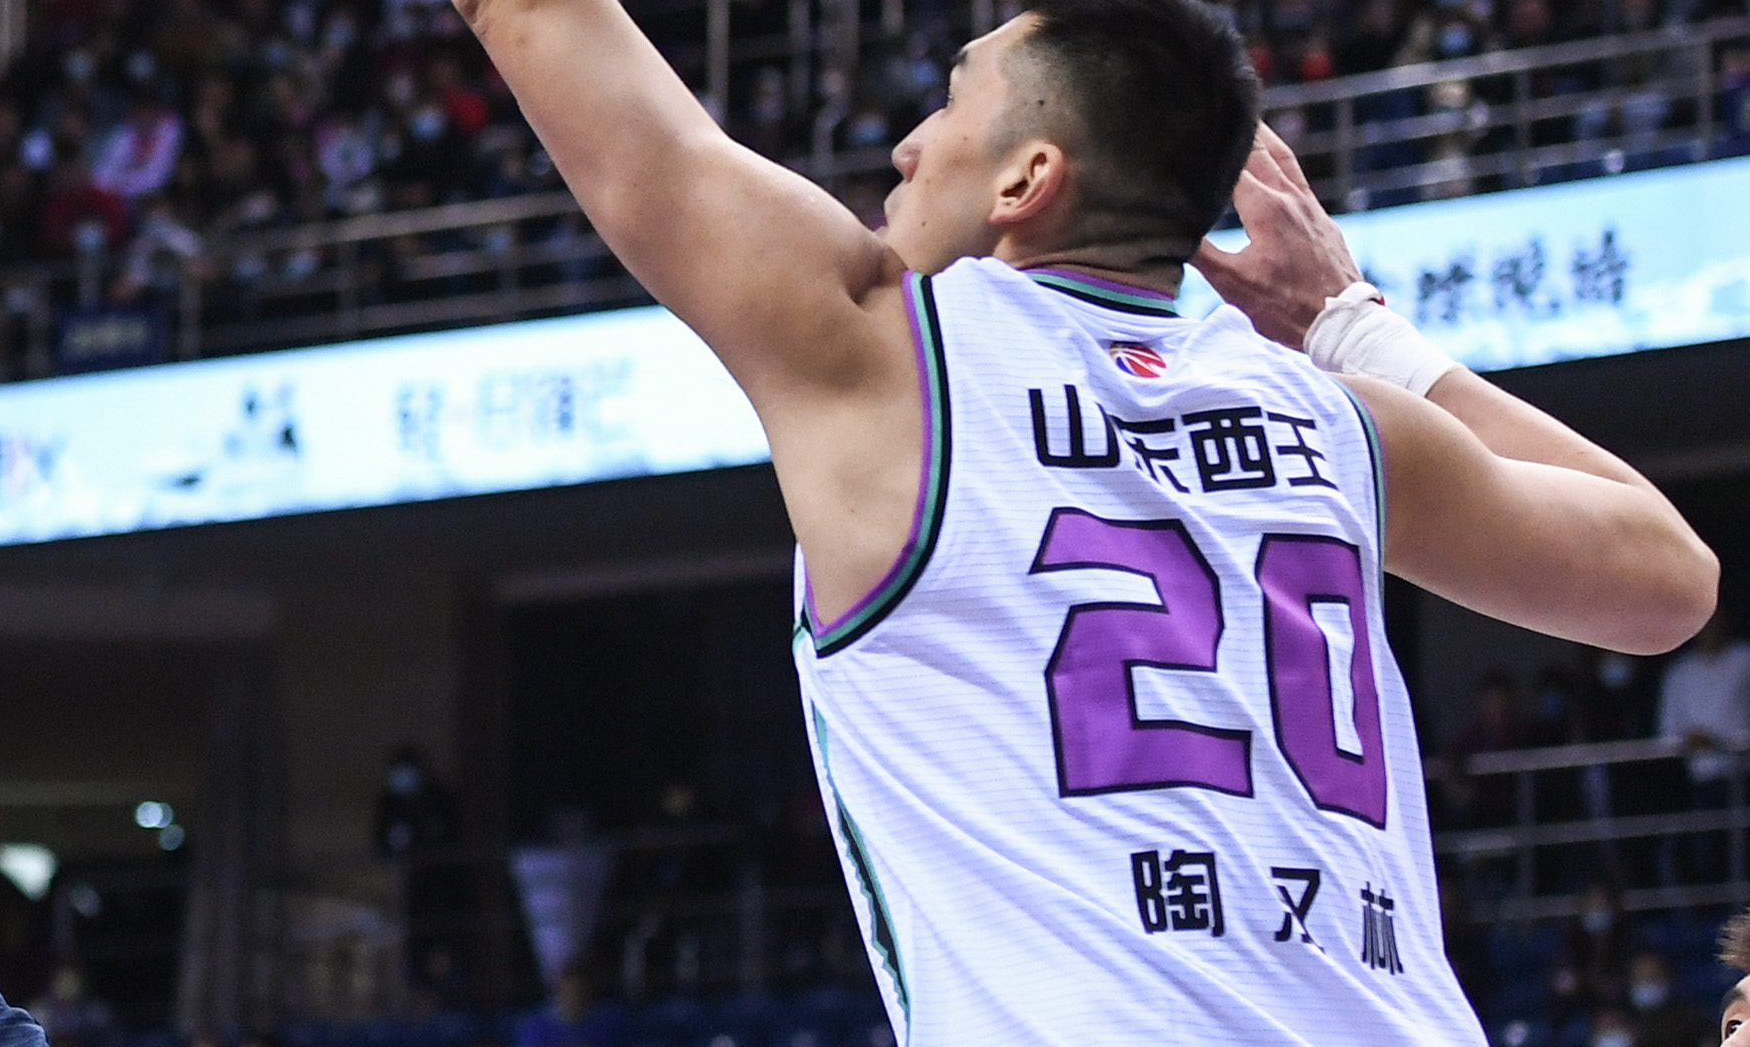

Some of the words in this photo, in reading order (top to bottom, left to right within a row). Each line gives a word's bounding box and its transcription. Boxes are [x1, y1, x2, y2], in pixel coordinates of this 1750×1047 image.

[1028, 384, 1339, 494] 山东西王
[1029, 507, 1387, 829] 20
